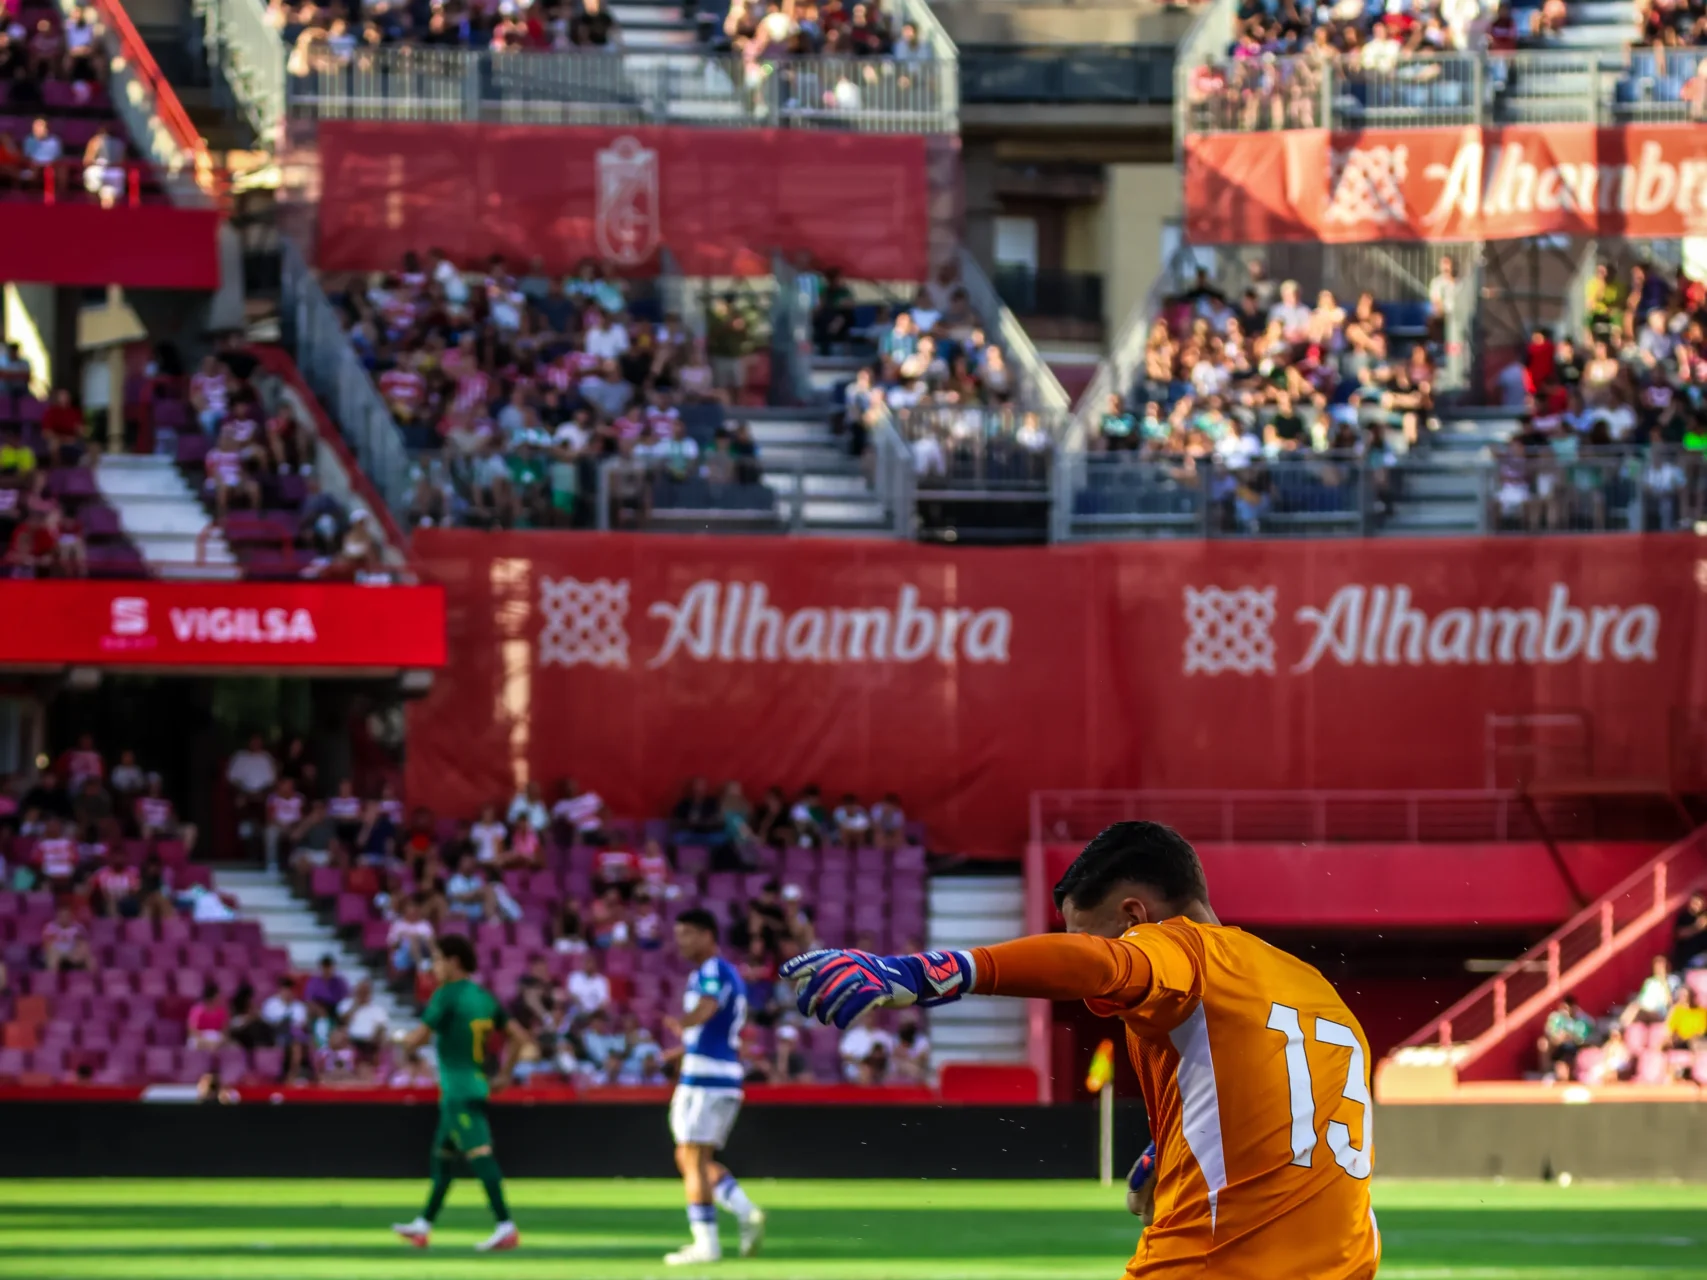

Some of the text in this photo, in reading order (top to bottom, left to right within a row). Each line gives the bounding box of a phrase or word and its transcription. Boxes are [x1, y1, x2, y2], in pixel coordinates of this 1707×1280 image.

[1420, 140, 1707, 225] Alhambr
[169, 606, 317, 643] VIGILSA
[647, 579, 1012, 669] Alhambra
[1291, 582, 1661, 675] Alhambra
[1266, 1002, 1373, 1180] 13
